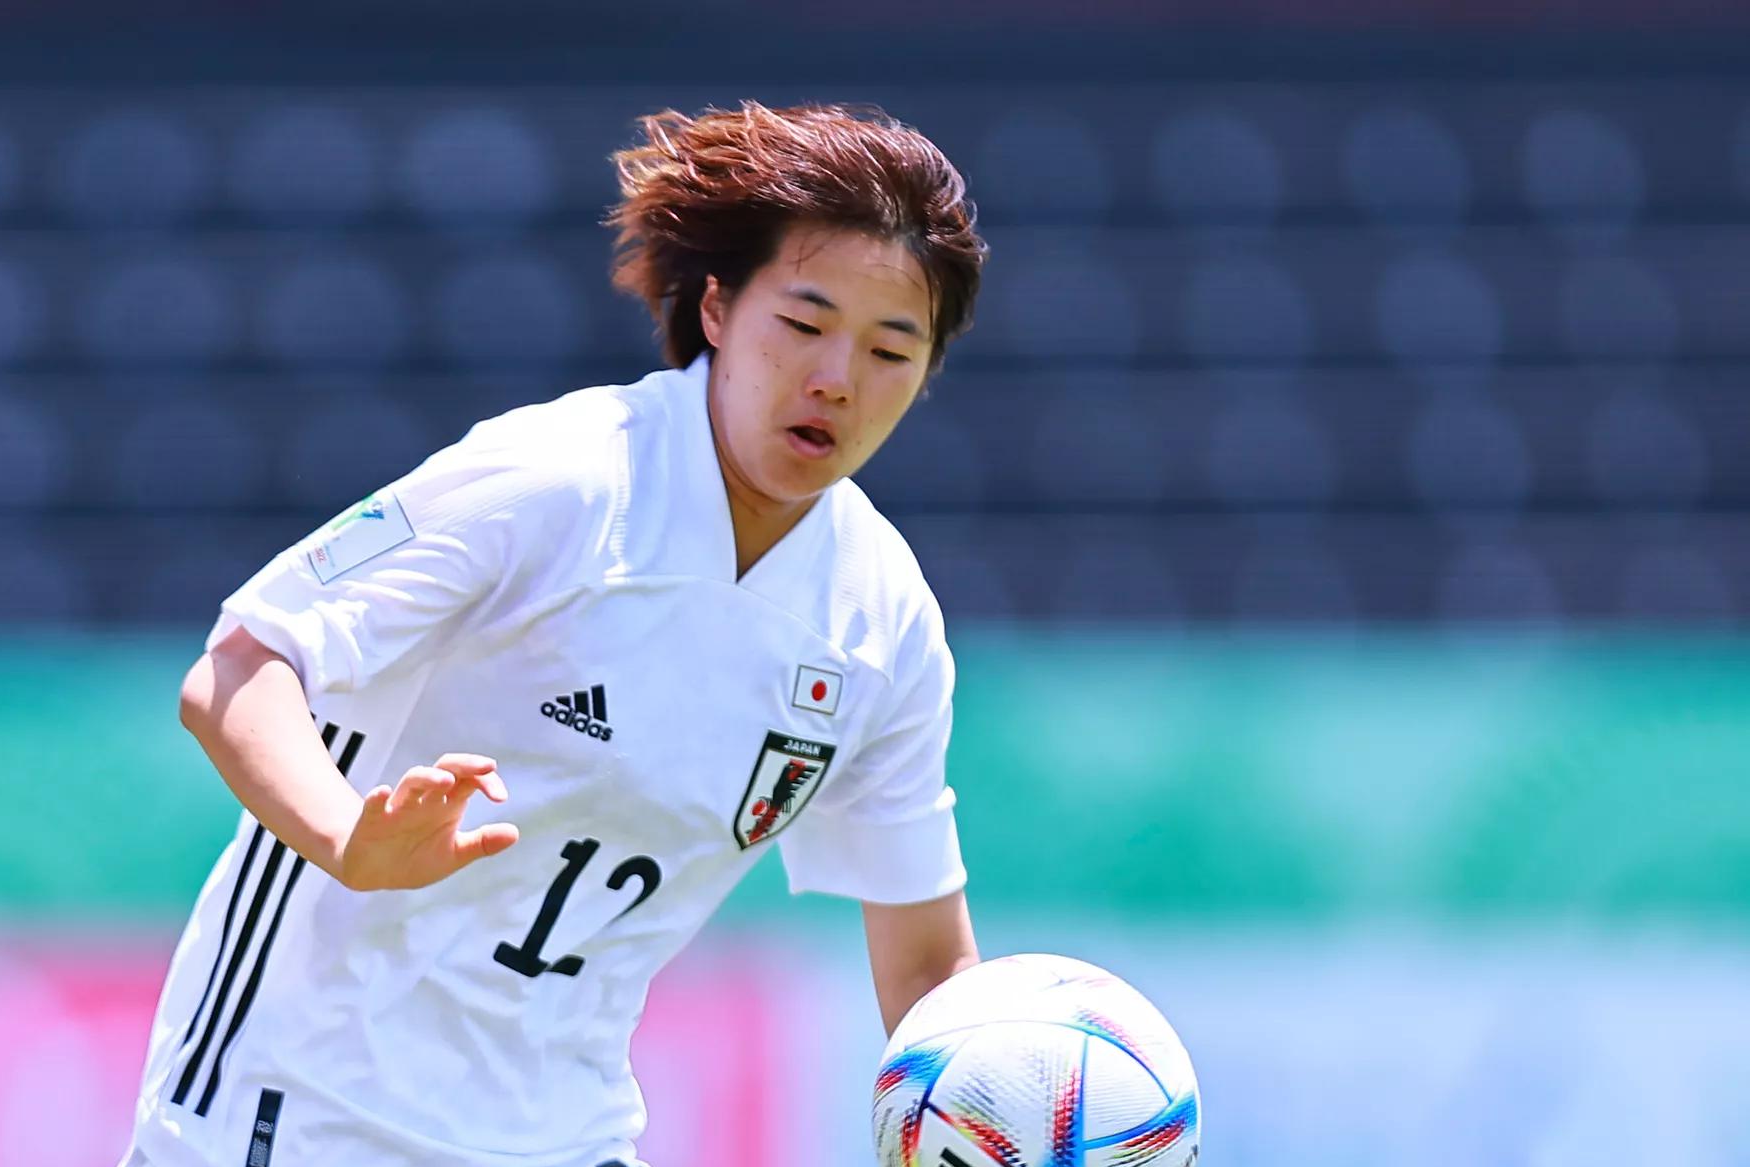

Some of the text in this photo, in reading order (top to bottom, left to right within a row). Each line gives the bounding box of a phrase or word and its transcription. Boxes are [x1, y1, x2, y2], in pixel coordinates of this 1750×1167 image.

[540, 700, 614, 742] adidas
[783, 739, 822, 757] JAPAN
[493, 838, 662, 978] 12
